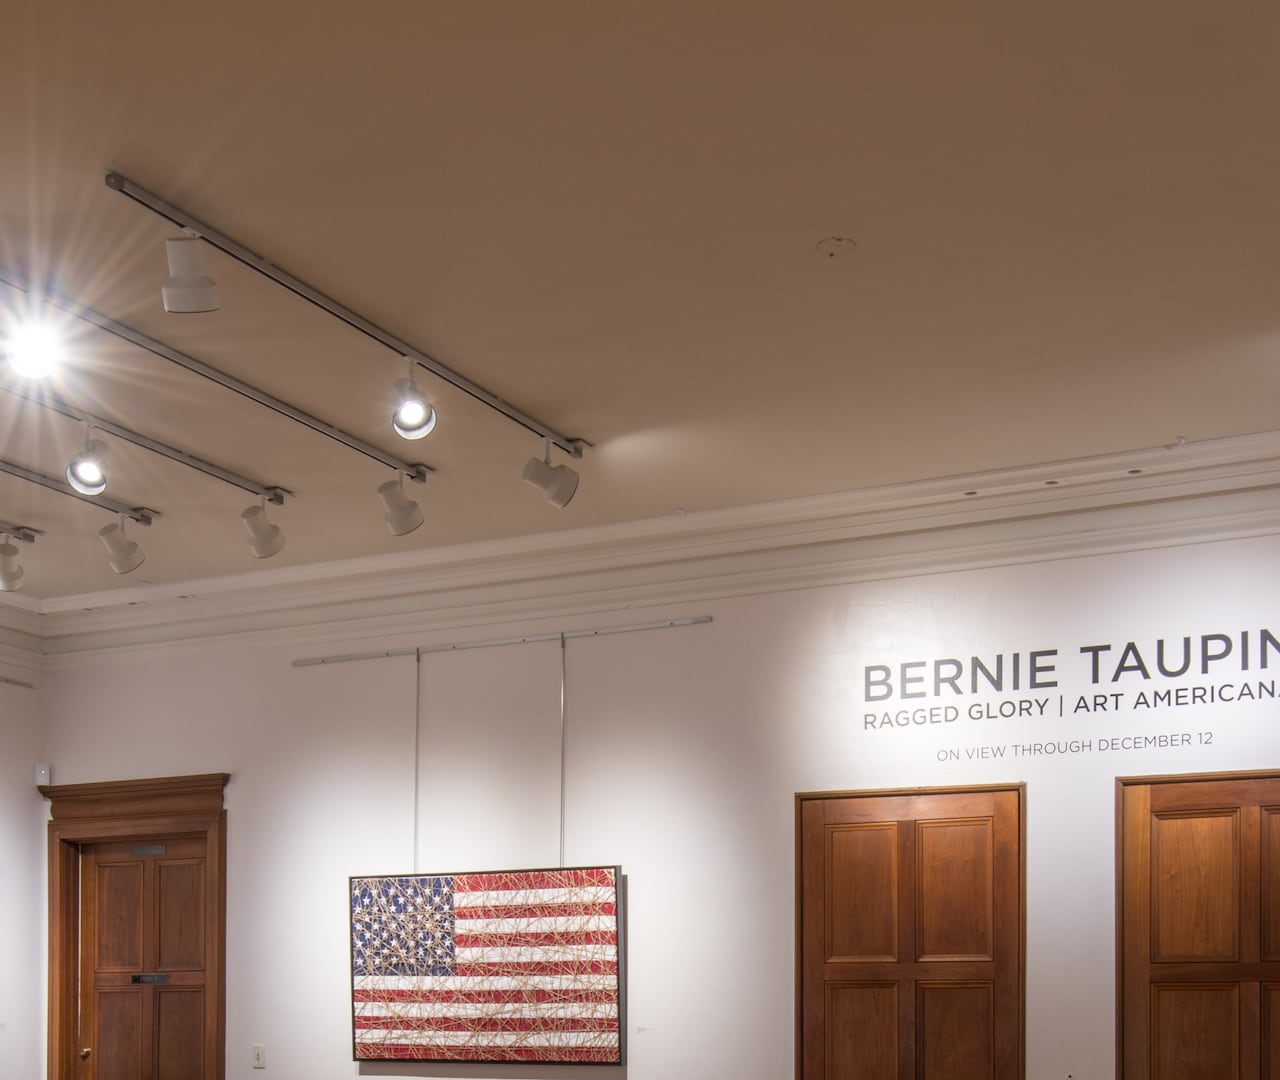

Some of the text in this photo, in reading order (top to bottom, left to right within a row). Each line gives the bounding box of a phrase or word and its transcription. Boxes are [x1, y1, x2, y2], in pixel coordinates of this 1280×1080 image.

[864, 648, 1059, 703] BERNIE
[863, 705, 960, 731] RAGGED
[967, 697, 1050, 721] GLORY
[1072, 692, 1125, 714] ART
[936, 731, 1214, 762] ON VIEW THROUGH DECEMBER 12
